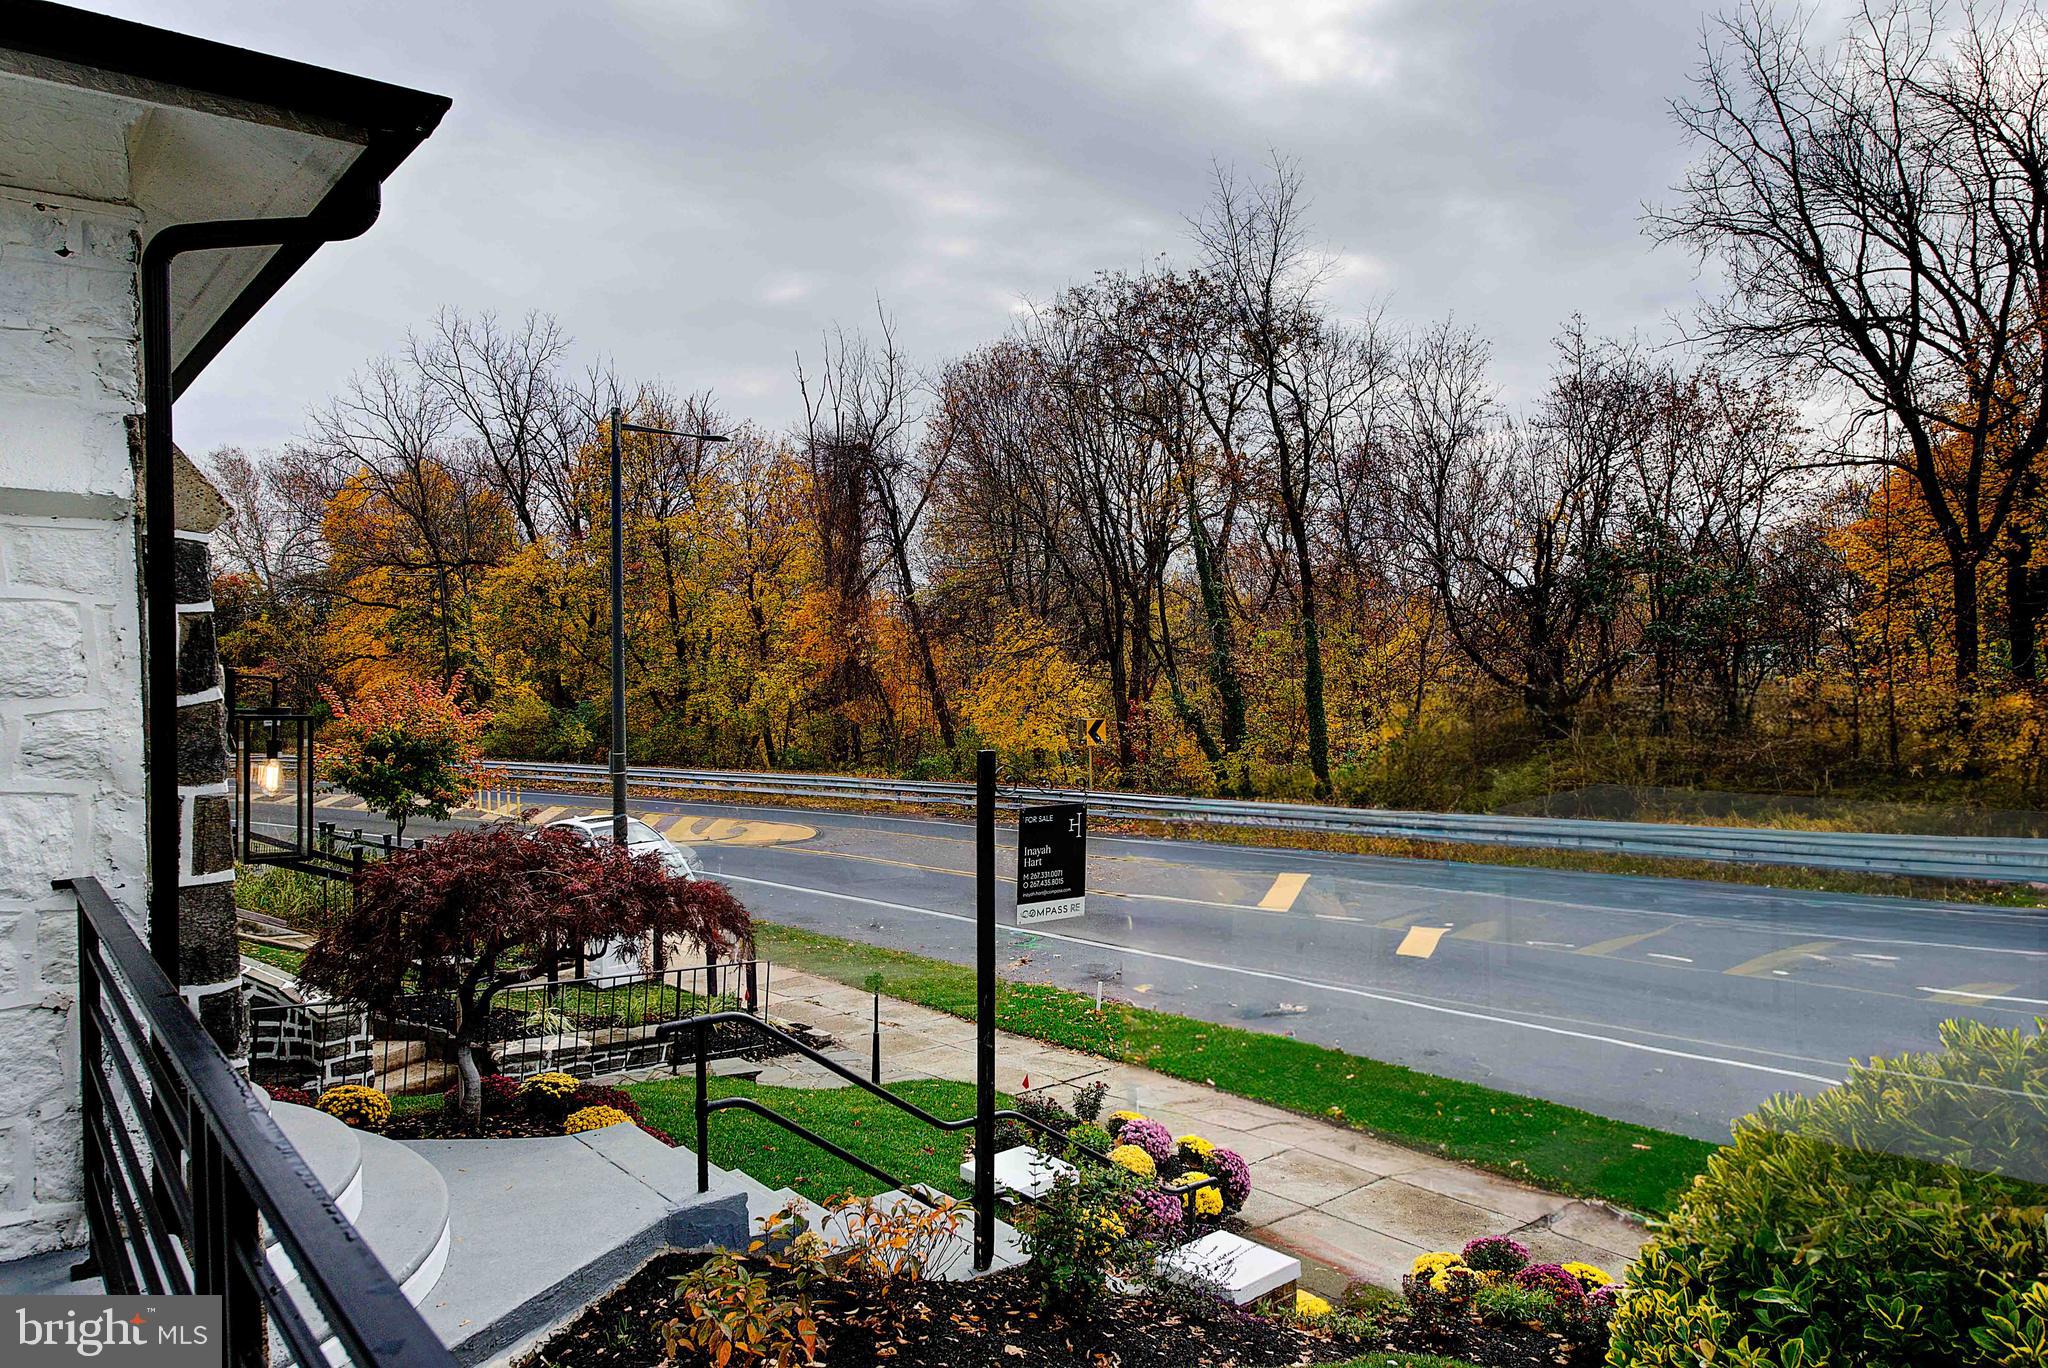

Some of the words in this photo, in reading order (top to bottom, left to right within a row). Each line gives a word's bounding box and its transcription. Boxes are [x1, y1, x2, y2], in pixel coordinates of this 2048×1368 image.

[1024, 815, 1038, 824] FOR
[1038, 814, 1054, 823] SALE
[1068, 812, 1083, 838] H
[1024, 844, 1052, 857] Inayah
[1024, 857, 1042, 868] Hart
[1022, 873, 1029, 881] M
[1020, 904, 1068, 918] COMPASS
[1070, 902, 1081, 913] RE
